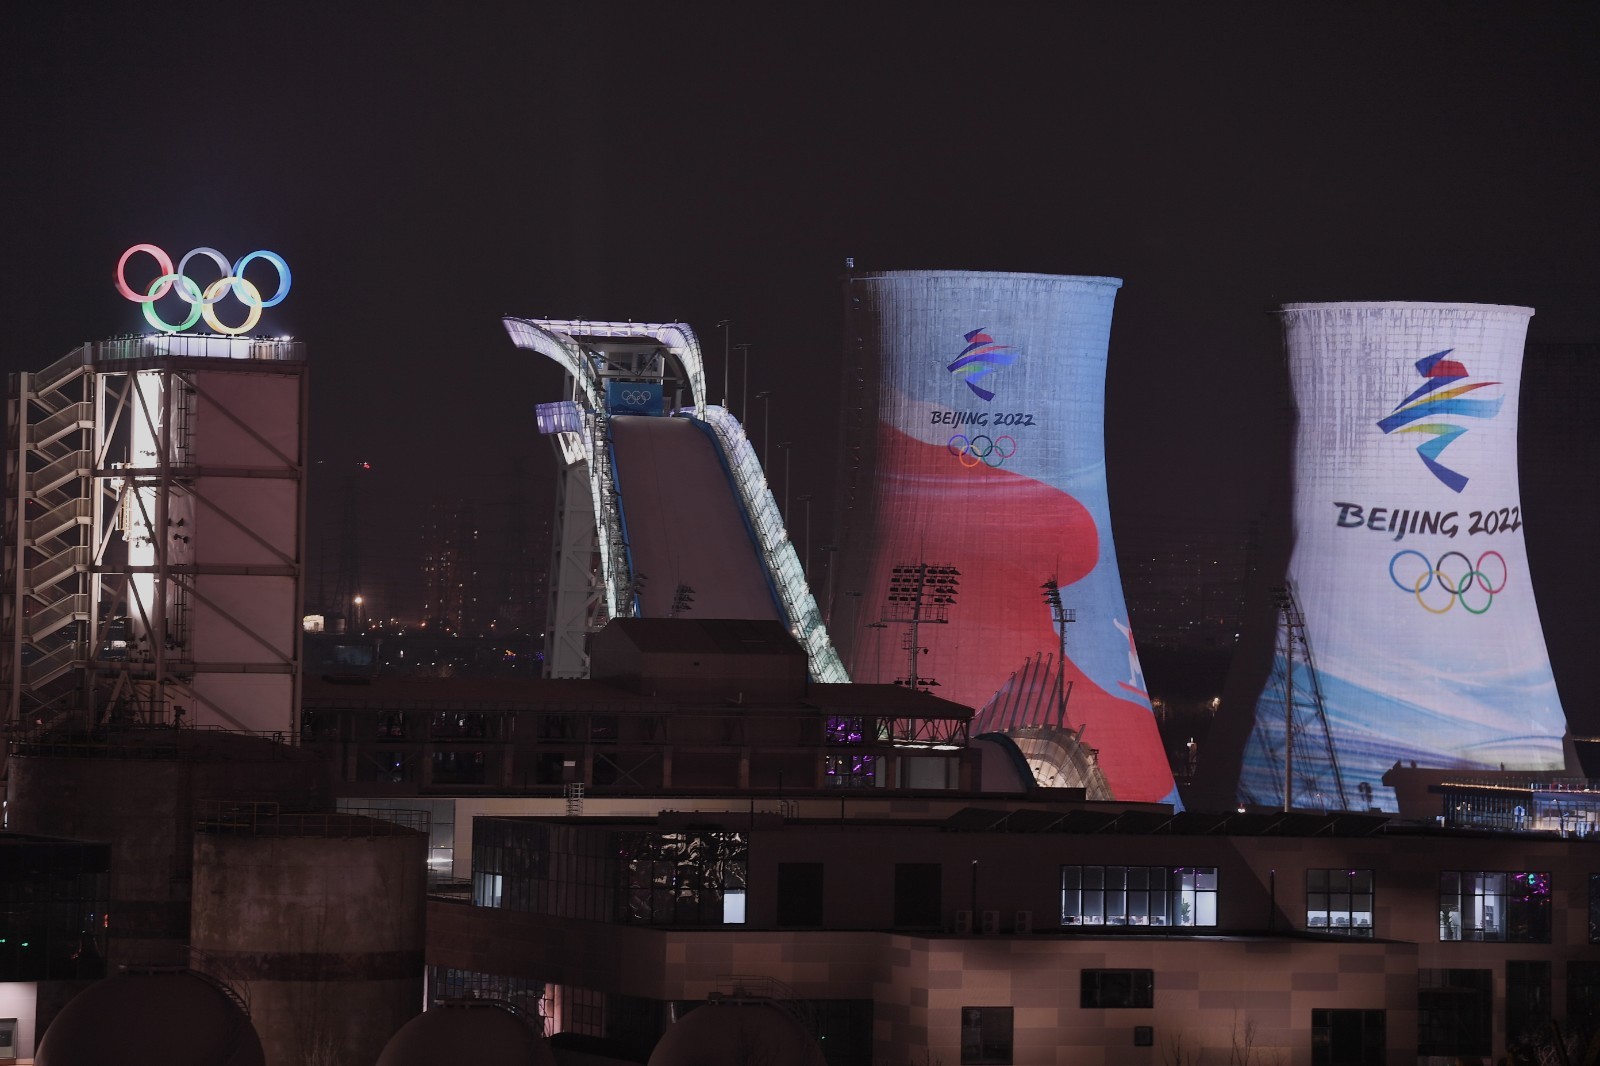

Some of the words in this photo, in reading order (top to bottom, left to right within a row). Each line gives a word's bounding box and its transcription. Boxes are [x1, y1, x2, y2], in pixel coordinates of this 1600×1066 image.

[931, 410, 988, 429] BEIJING
[993, 412, 1036, 426] 2022
[1333, 501, 1459, 542] BEIJING
[1468, 506, 1521, 536] 2022
